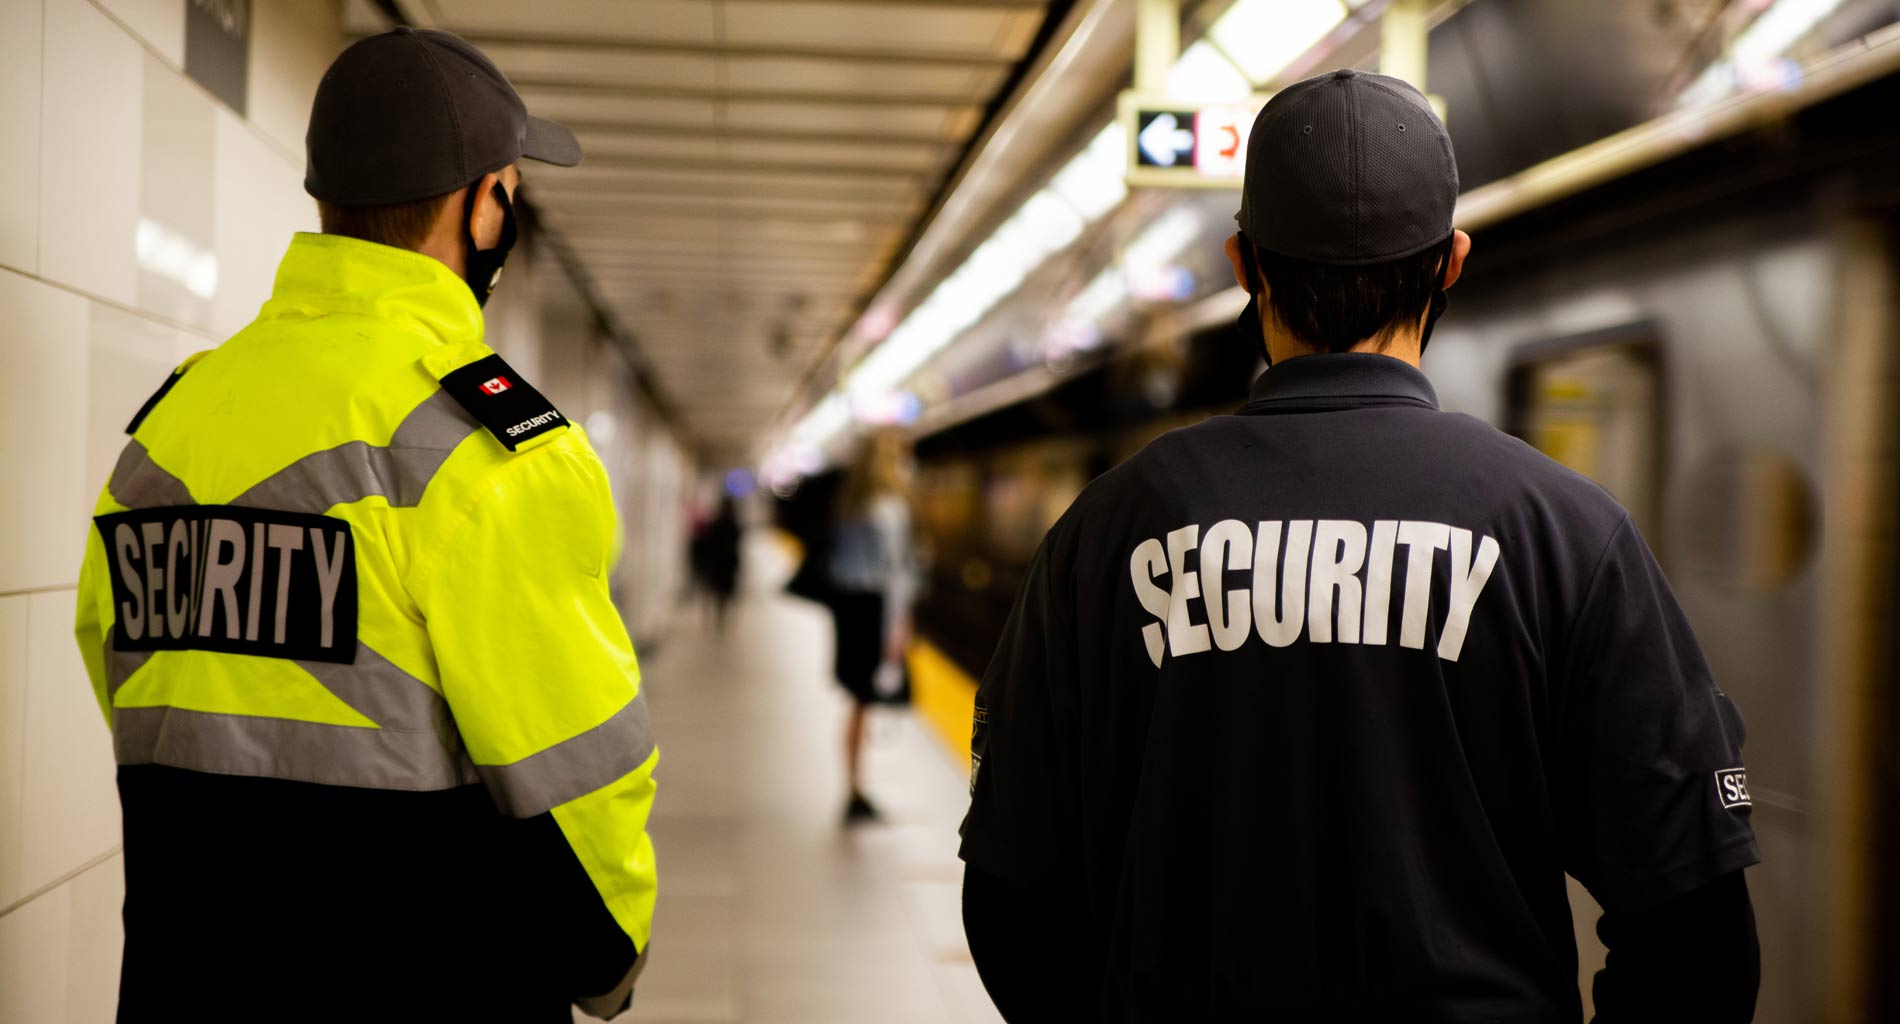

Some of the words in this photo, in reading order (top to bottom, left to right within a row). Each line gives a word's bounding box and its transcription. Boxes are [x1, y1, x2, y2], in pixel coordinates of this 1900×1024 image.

[506, 410, 560, 437] SECURITY
[115, 518, 346, 648] SECURITY
[1130, 519, 1500, 669] SECURITY
[1723, 774, 1750, 801] SE
